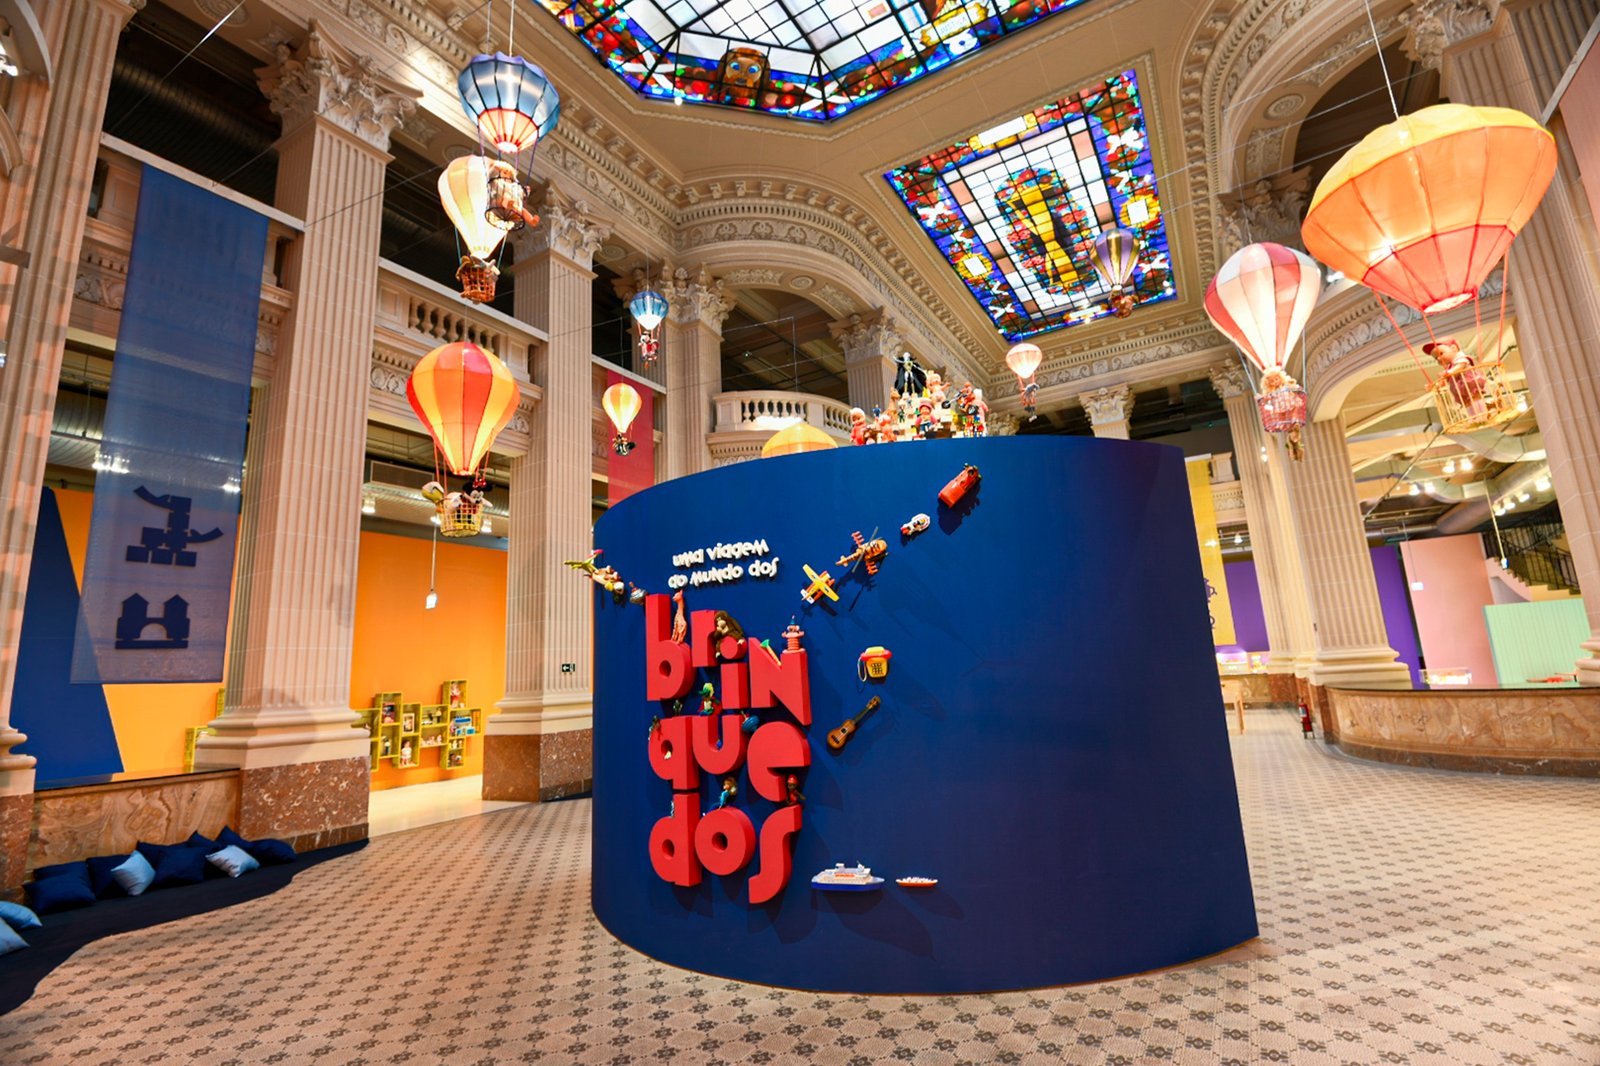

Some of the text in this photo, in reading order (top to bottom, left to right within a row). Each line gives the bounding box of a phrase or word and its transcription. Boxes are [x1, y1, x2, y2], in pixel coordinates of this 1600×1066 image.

[668, 574, 688, 589] ao
[748, 557, 779, 577] dos
[648, 792, 803, 904] dos
